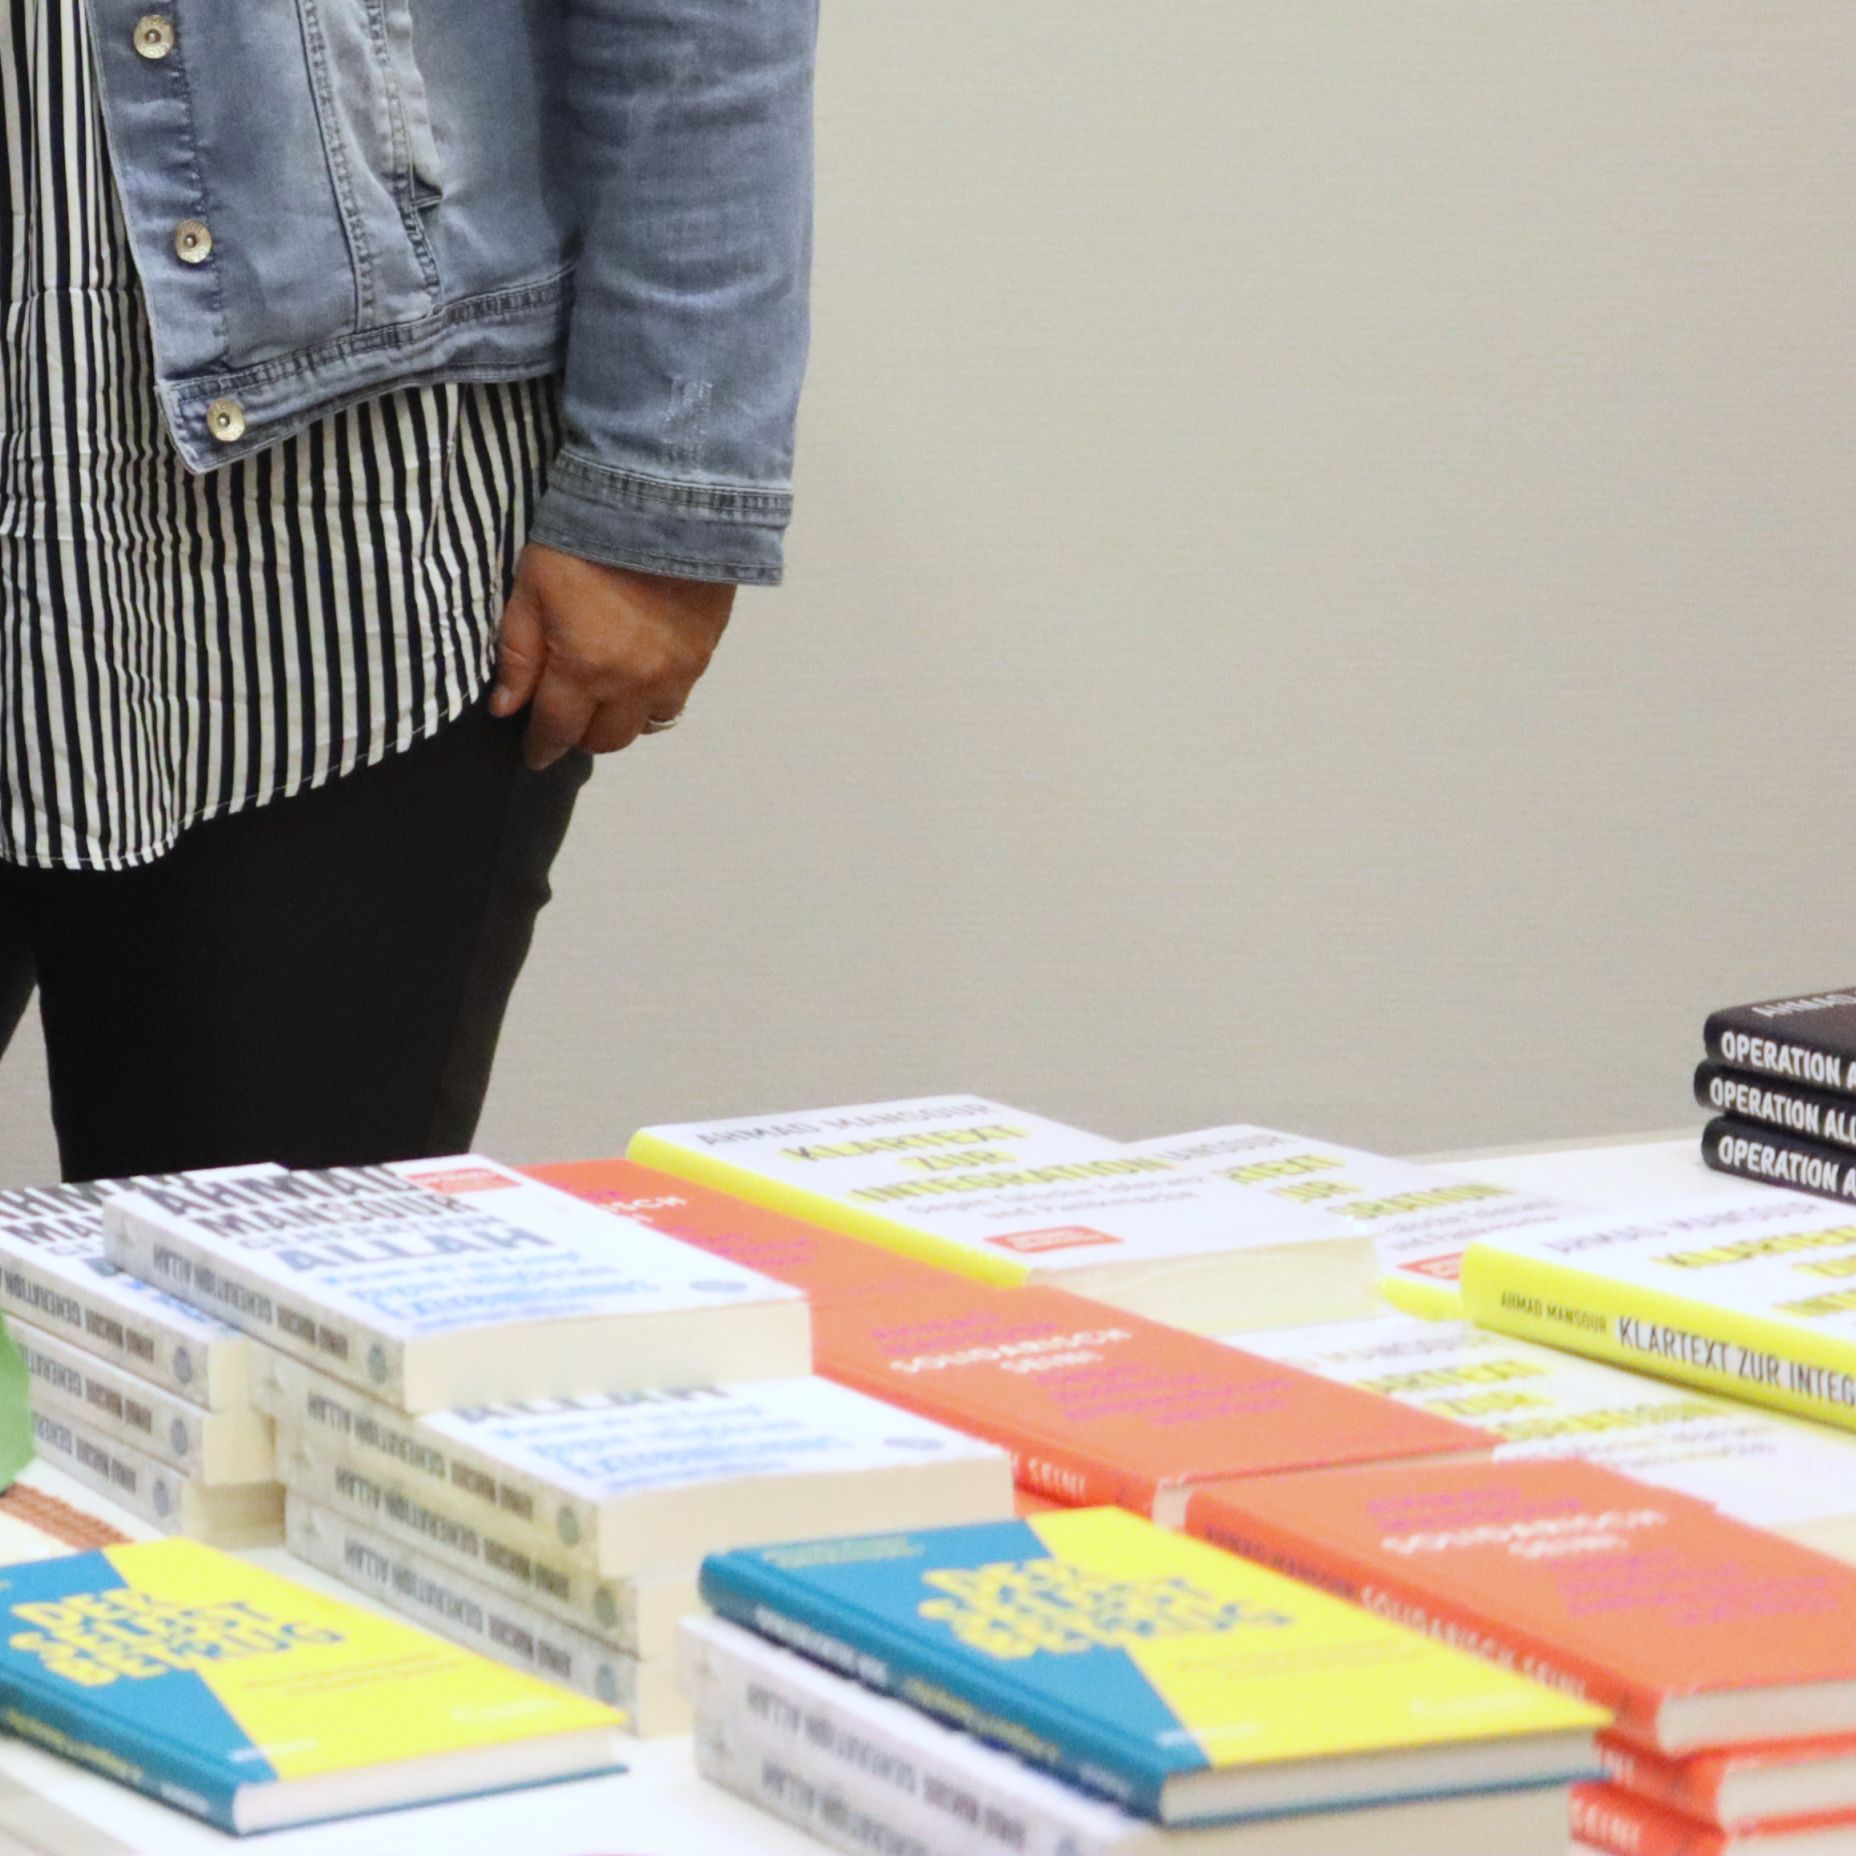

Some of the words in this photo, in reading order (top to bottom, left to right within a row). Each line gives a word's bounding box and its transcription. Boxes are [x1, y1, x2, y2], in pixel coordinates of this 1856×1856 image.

[1721, 1030, 1840, 1087] OPERATION
[1710, 1077, 1819, 1134] OPERATION
[1718, 1135, 1839, 1193] OPERATION
[1501, 1291, 1543, 1320] AHMAD
[1546, 1301, 1609, 1335] MANSOUR
[1618, 1314, 1731, 1374] KLARTEXT
[1738, 1347, 1781, 1387] ZUR
